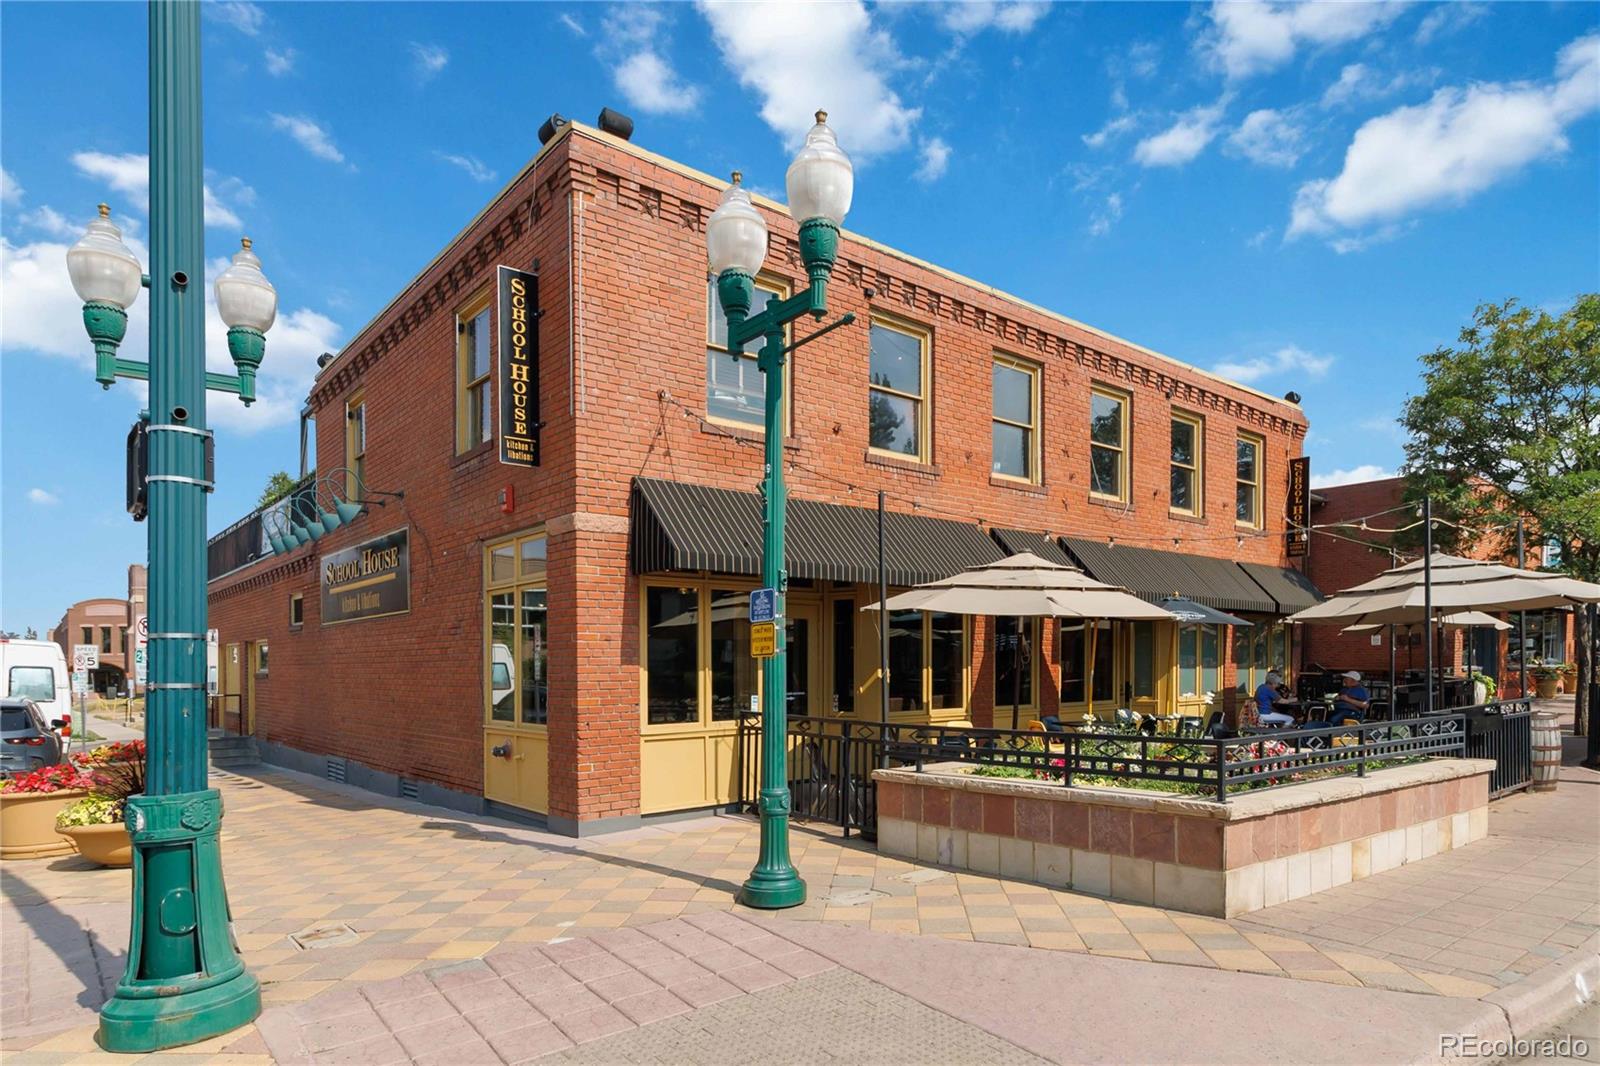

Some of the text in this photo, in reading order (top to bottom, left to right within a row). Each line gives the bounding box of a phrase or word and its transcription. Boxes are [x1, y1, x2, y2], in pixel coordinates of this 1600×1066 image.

[510, 278, 530, 434] SCHOOL HOUSE
[1294, 462, 1303, 503] SCHOOL
[326, 547, 399, 586] SCHOOL HOUSE
